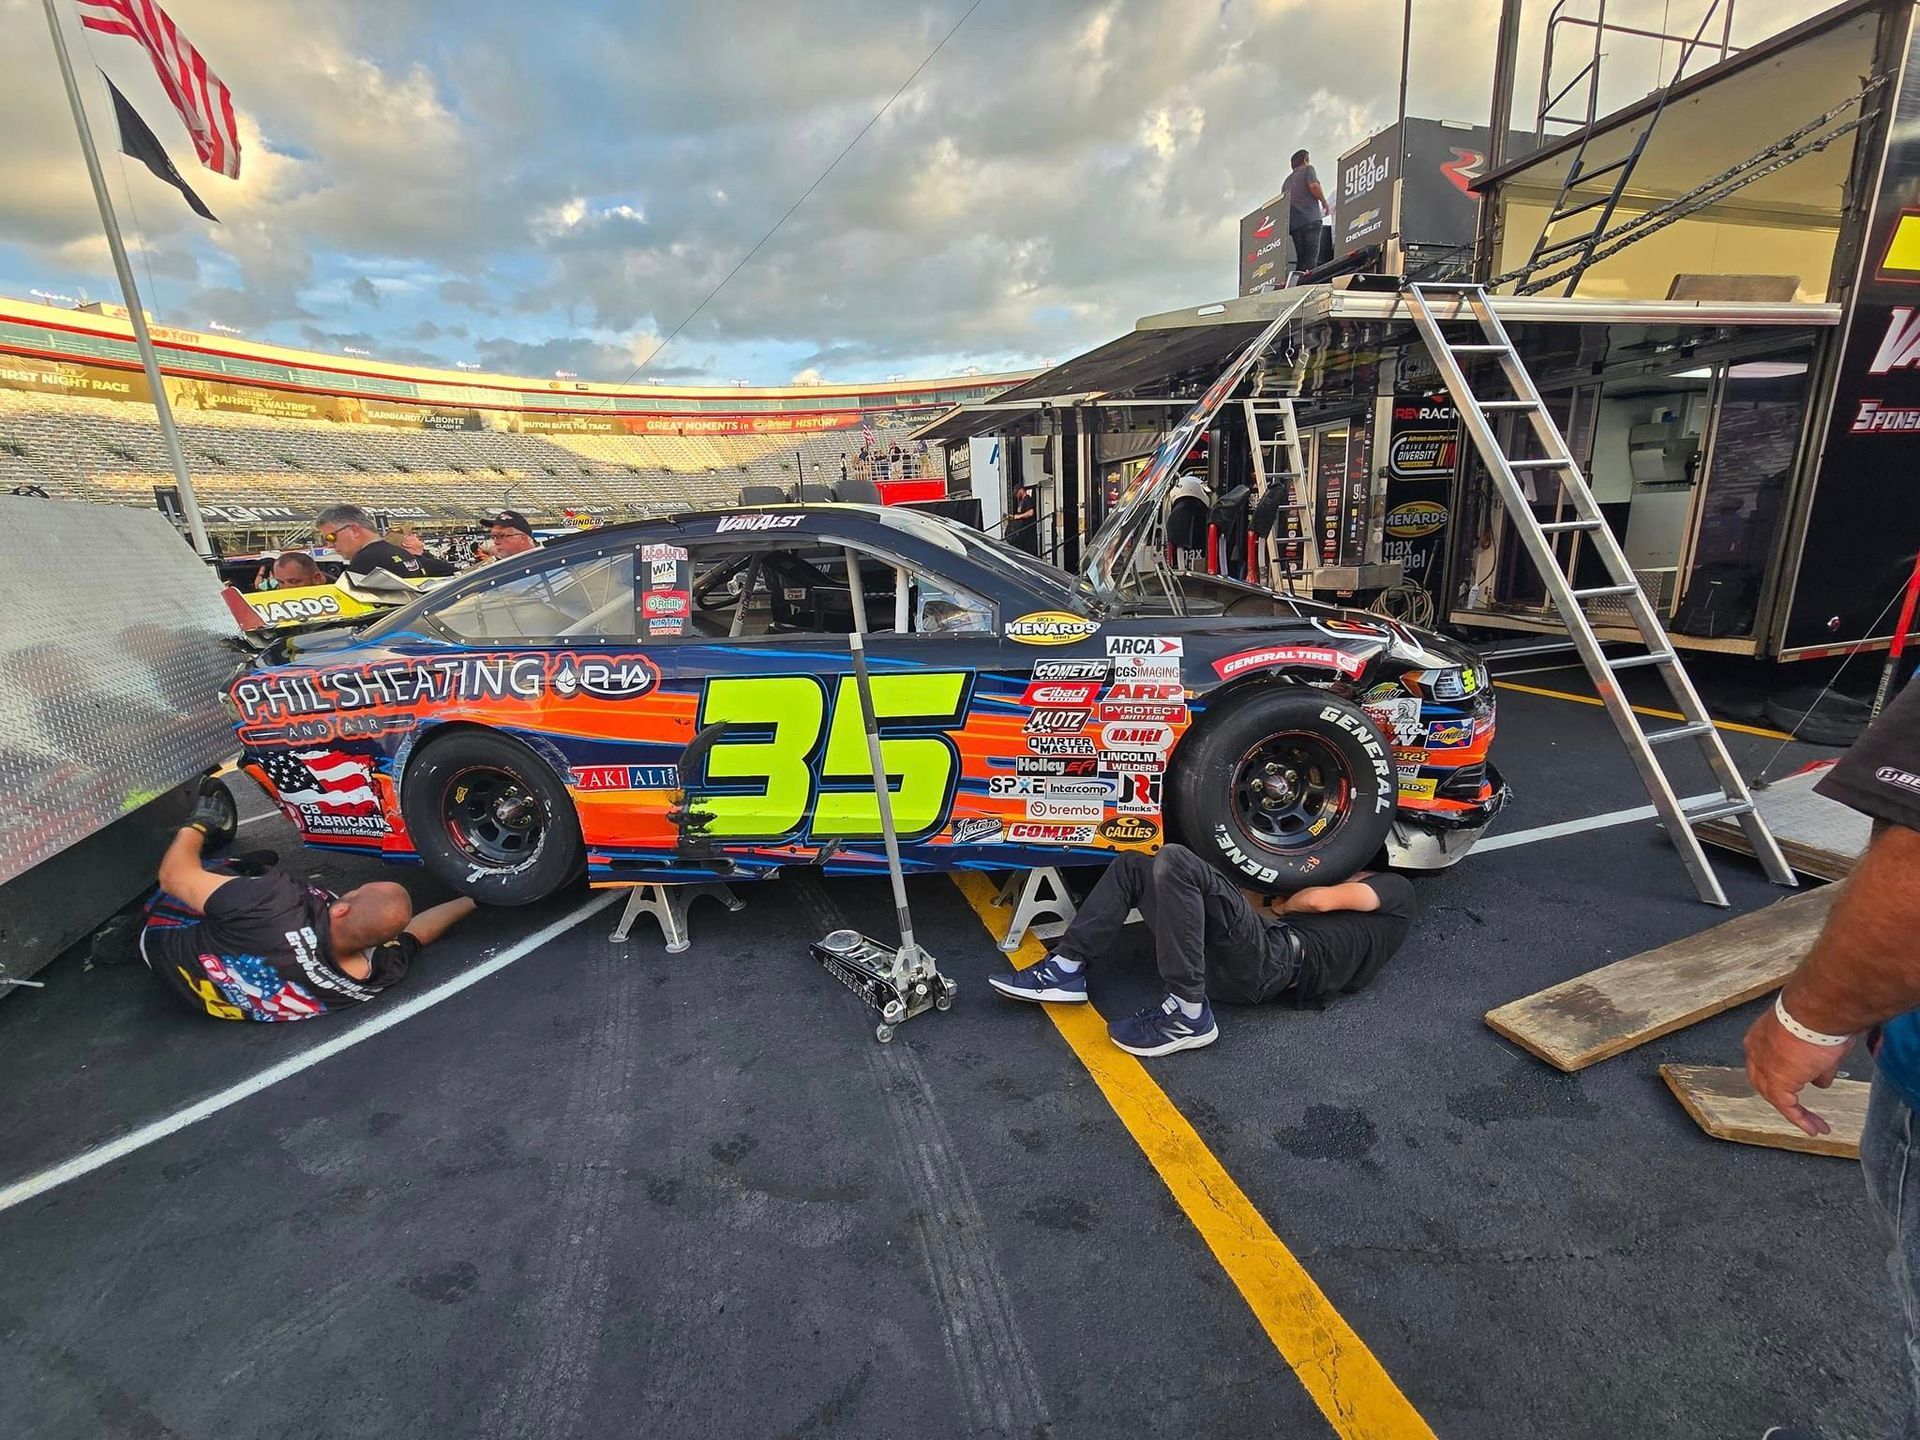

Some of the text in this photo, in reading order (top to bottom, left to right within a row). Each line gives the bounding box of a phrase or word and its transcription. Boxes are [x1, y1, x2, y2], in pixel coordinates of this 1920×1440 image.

[1345, 154, 1378, 182] max
[1345, 221, 1383, 243] CHEVROLET
[149, 328, 169, 338] OOD
[42, 374, 89, 388] NIGHT
[92, 380, 130, 393] RACE
[212, 394, 317, 413] DARRELL WALTRIP'S
[1396, 407, 1461, 420] REVRACIN
[1852, 402, 1920, 430] SPONS
[589, 423, 612, 431] TRACK
[647, 421, 683, 431] GREAT
[685, 421, 738, 431] MOMENTS
[796, 418, 839, 428] HISTORY
[1397, 450, 1438, 461] DIVERSITY
[565, 517, 602, 526] SUNOCO
[653, 561, 674, 576] WIX
[256, 596, 339, 622] NARDS
[649, 597, 685, 611] O'Reilly
[650, 618, 682, 628] NORTON
[1004, 621, 1099, 636] MENARDS
[1109, 639, 1156, 655] ARCA
[1223, 650, 1333, 674] GENERAL TIRE
[1034, 662, 1109, 678] COMETIC
[1032, 687, 1090, 703] Eibach
[1107, 683, 1184, 699] ARP
[1105, 705, 1182, 715] PYROTECT
[1362, 706, 1394, 716] Sioux
[1035, 710, 1088, 728] KLOTZ
[288, 718, 378, 738] AND AIR
[1111, 728, 1165, 742] DART
[1429, 730, 1471, 741] SUNOCO
[1029, 737, 1092, 749] QUARTER
[1040, 745, 1095, 755] MASTER
[689, 672, 967, 836] 35
[1100, 751, 1155, 763] LINCOLN
[1319, 706, 1392, 815] GENERAL
[1393, 751, 1430, 762] ese's
[1018, 756, 1066, 774] Holley
[1112, 762, 1159, 772] WELDERS
[575, 770, 629, 788] ZAKI
[633, 769, 668, 787] ALI
[1050, 783, 1108, 796] Intercomp
[300, 803, 320, 815] CB
[1049, 804, 1100, 816] brembo
[1118, 804, 1153, 812] shocks
[308, 827, 333, 835] Custom
[333, 828, 351, 836] Metal
[954, 819, 1001, 843] Jostens
[1012, 824, 1076, 839] COMP
[1106, 826, 1153, 839] CALLIES
